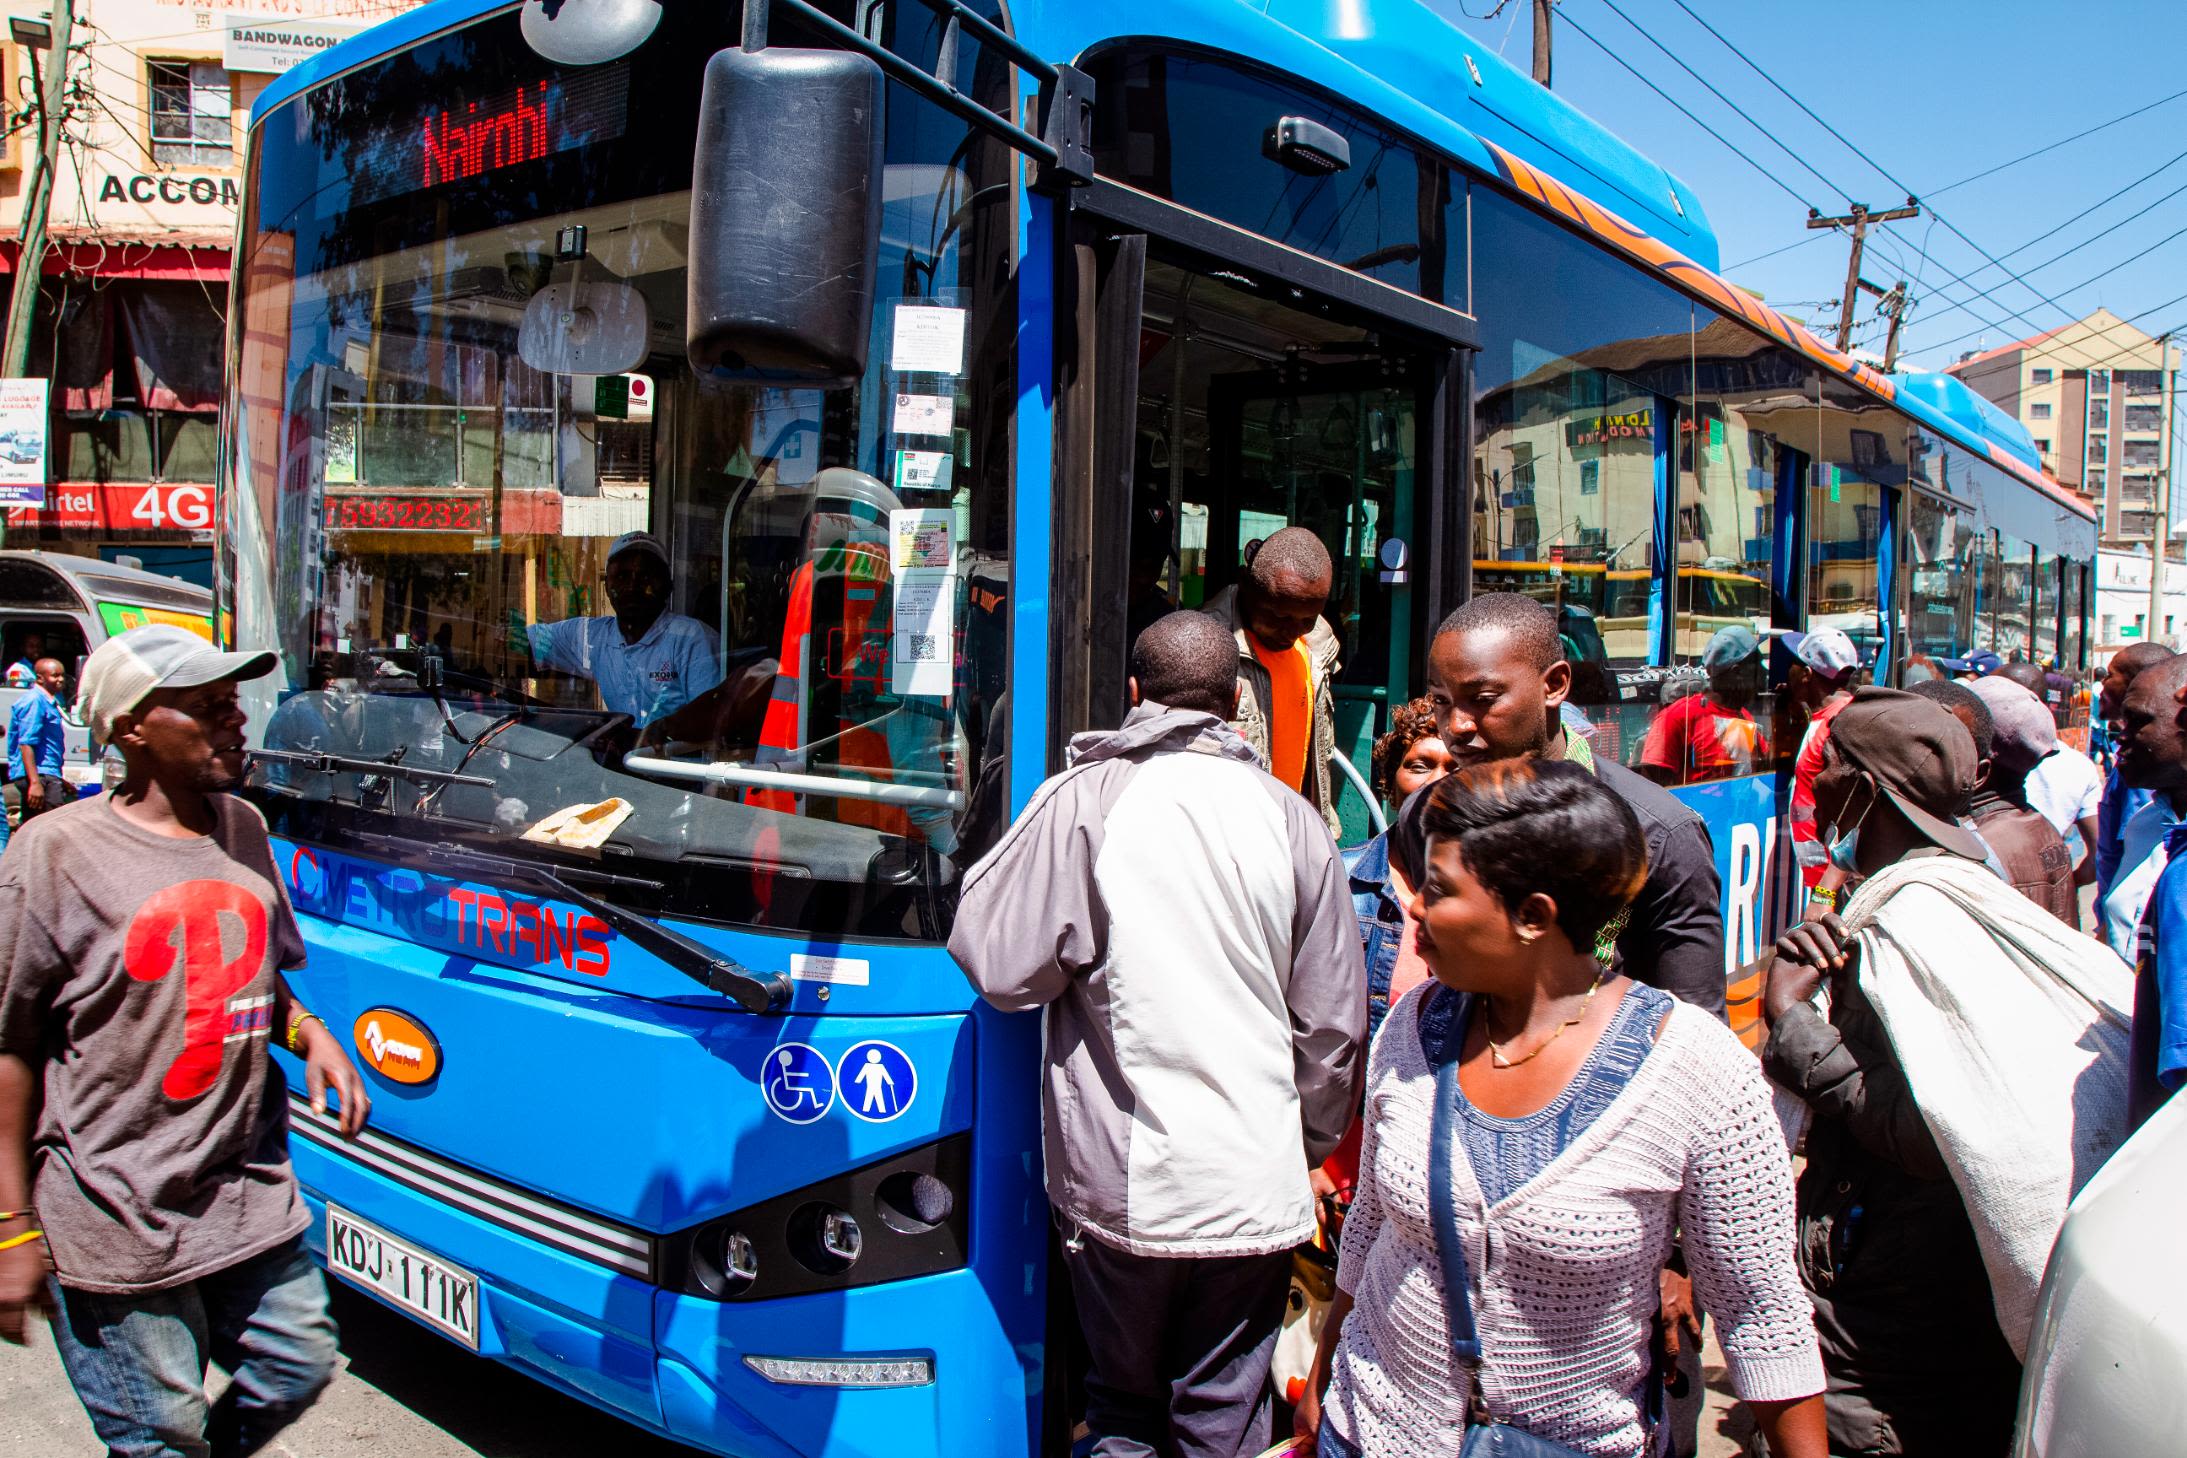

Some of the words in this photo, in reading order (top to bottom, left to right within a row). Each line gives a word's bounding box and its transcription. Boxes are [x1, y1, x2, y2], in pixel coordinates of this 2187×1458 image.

[232, 29, 337, 49] BANDWAGON
[39, 490, 95, 512] irtel
[132, 486, 208, 527] 4G
[333, 1218, 384, 1282] KDJ
[401, 1255, 469, 1333] 111K
